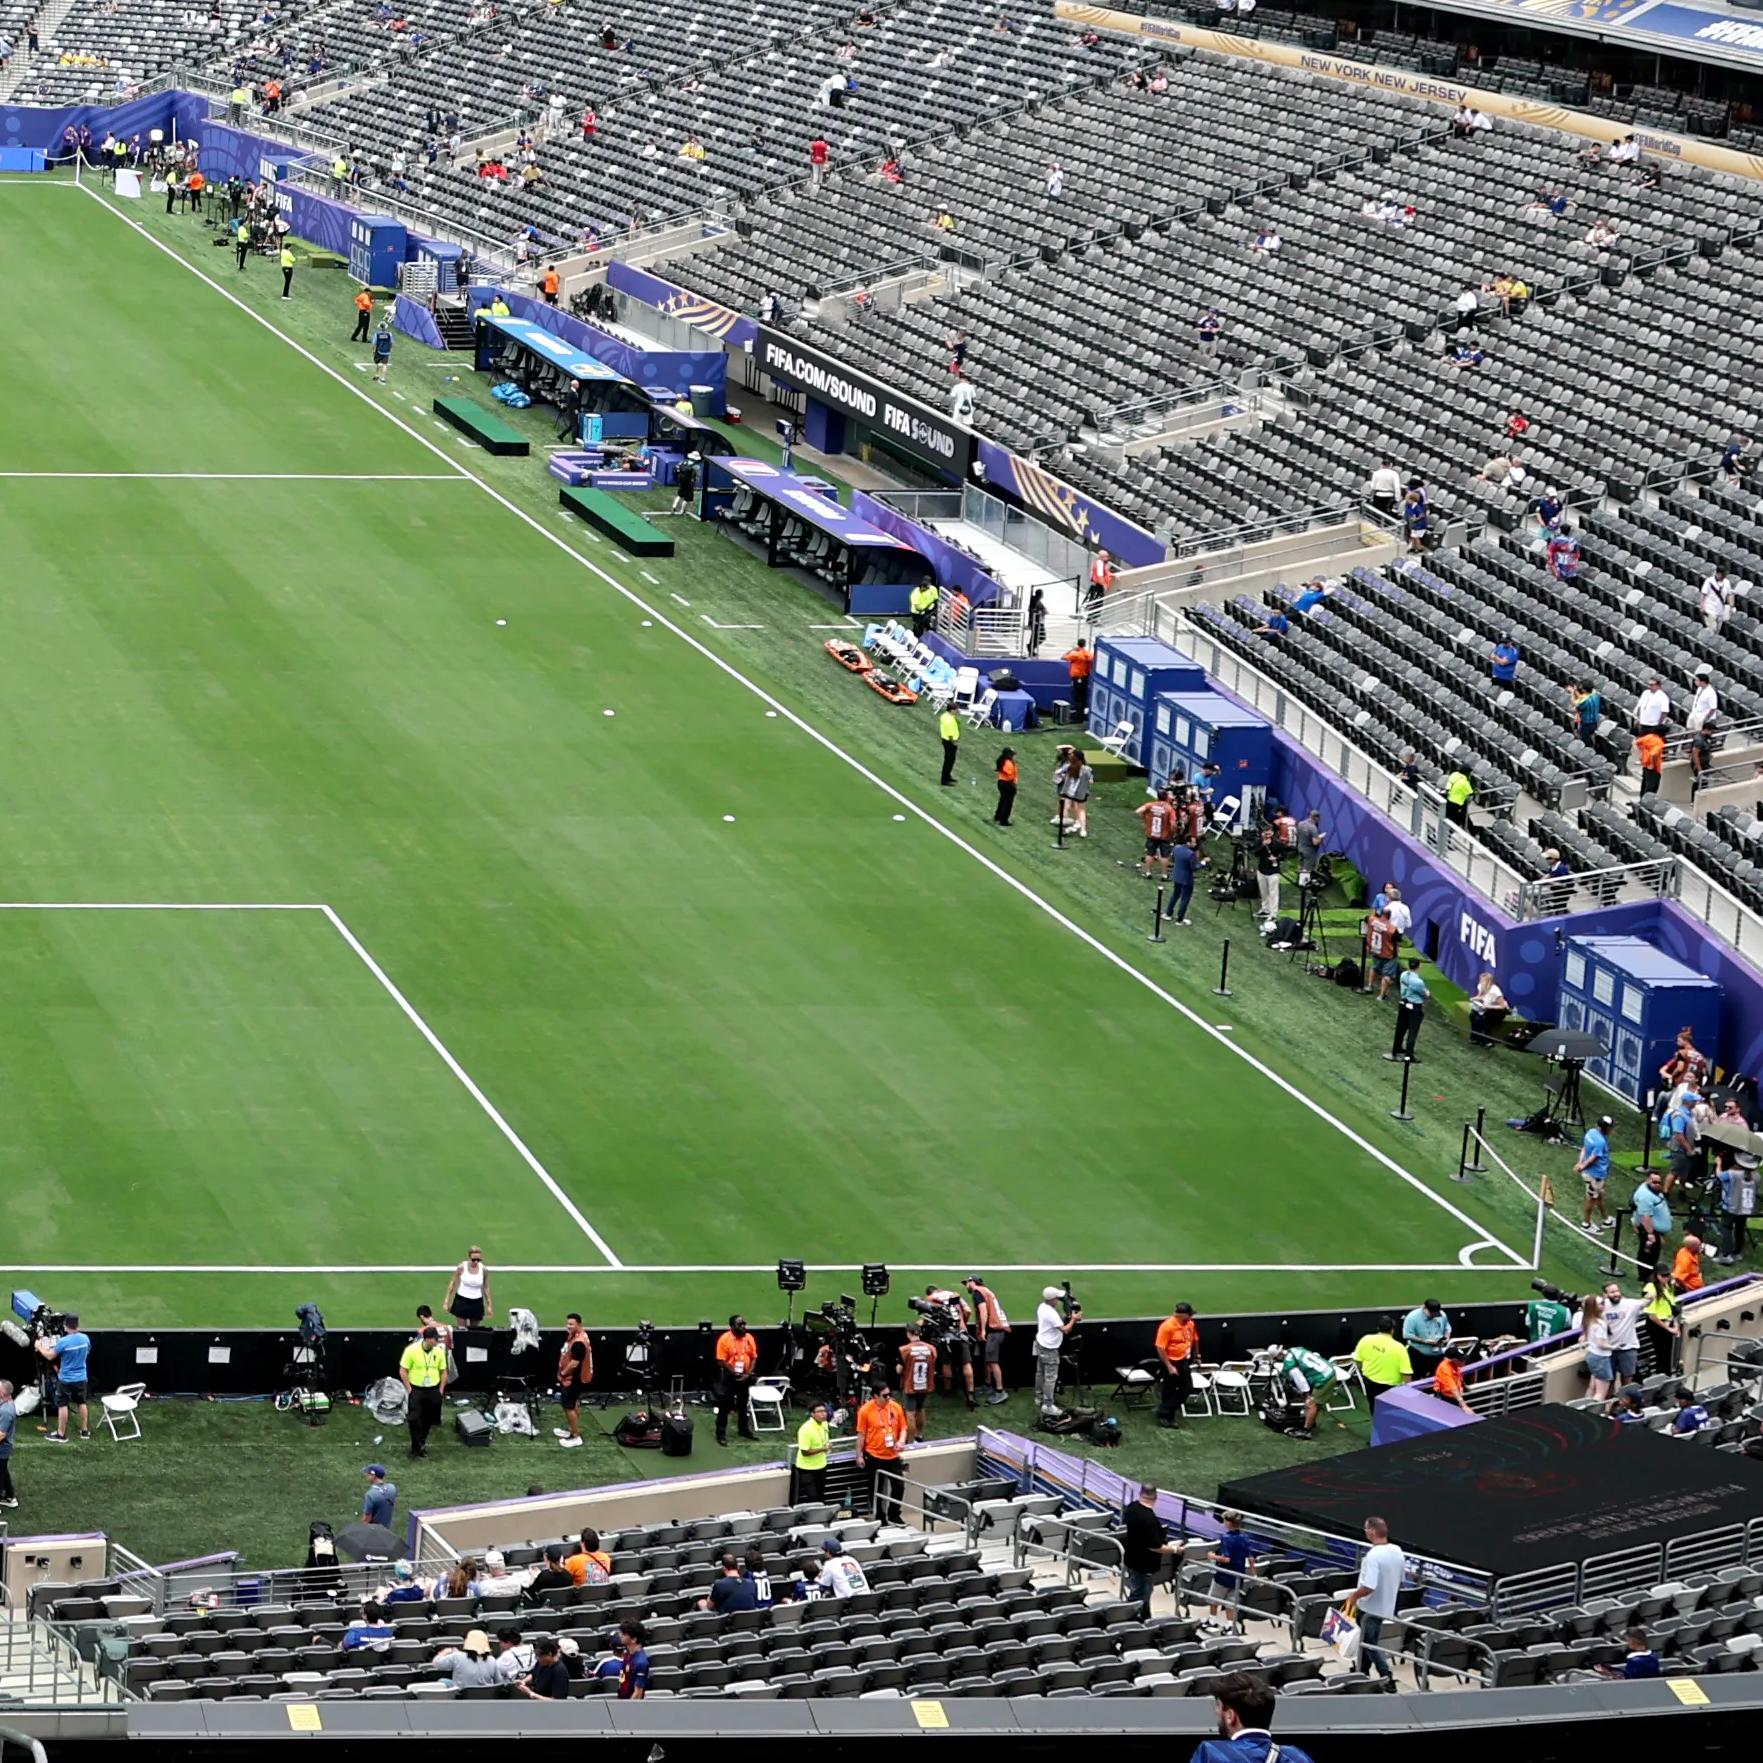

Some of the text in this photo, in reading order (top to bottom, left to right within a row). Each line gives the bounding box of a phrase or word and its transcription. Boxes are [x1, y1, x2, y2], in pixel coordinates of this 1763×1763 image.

[1300, 55, 1467, 102] NEW YORK NEW JERSEY
[275, 191, 293, 213] FIFA
[766, 342, 877, 418] FIFA.COM/SOUND
[1460, 912, 1497, 968] FIFA
[754, 1578, 771, 1600] 10
